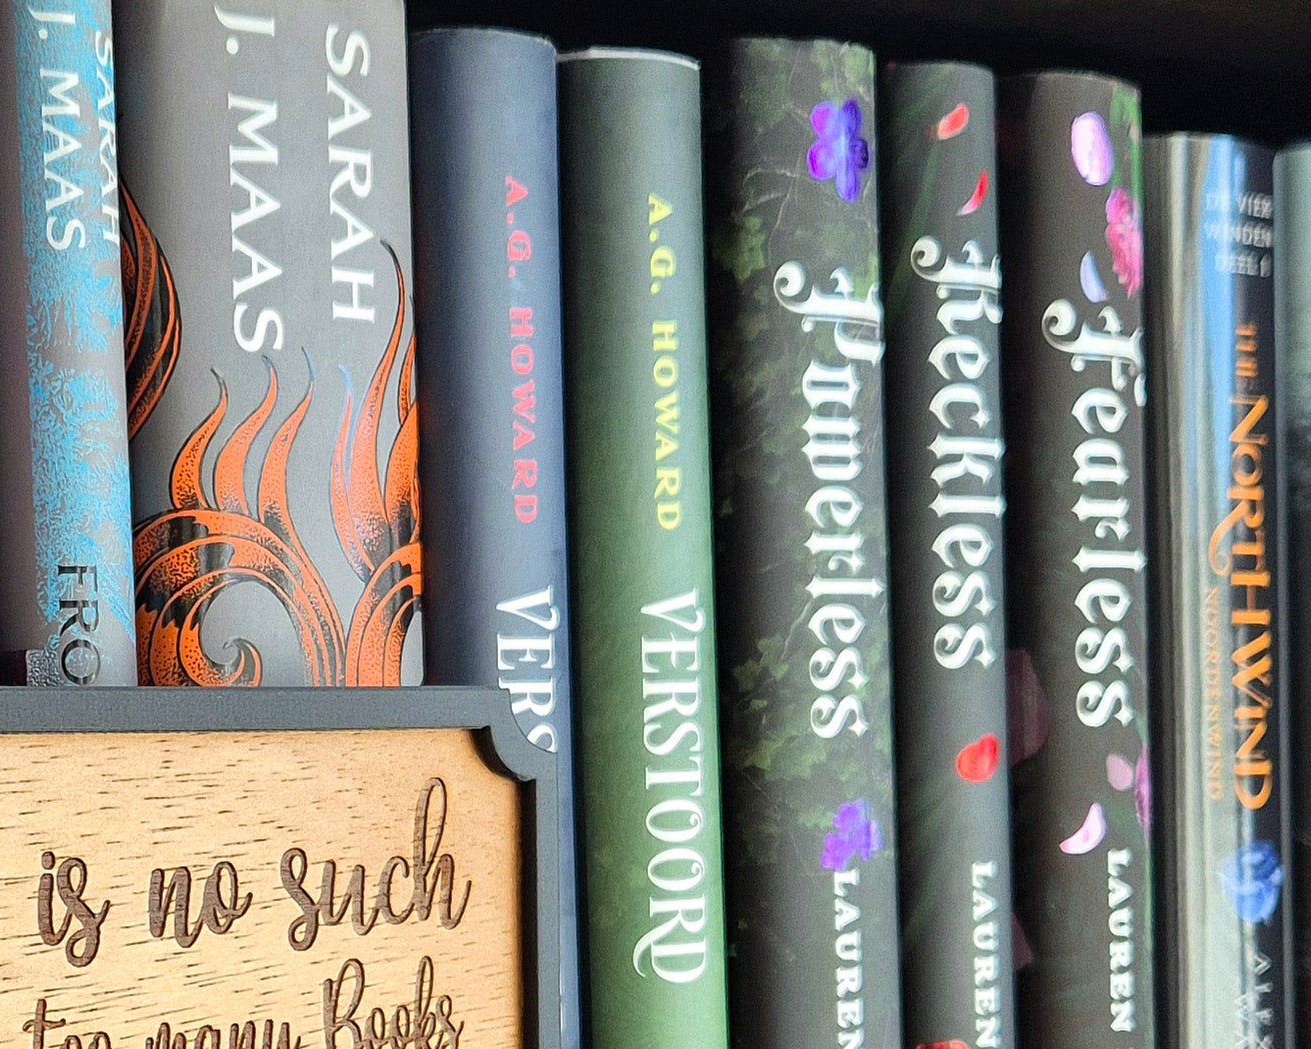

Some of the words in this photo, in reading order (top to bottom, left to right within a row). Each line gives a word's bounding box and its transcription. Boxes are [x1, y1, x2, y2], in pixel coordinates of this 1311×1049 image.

[29, 5, 77, 40] J.
[214, 6, 275, 55] J.
[39, 66, 87, 252] MAAS
[94, 29, 121, 245] SARAH
[227, 91, 285, 353] MAAS
[324, 22, 377, 324] SARAH
[504, 174, 533, 279] A.G.
[648, 193, 677, 295] A.G.
[507, 306, 541, 526] HOWARD
[652, 320, 682, 531] HOWARD
[773, 260, 886, 738] Powerless
[910, 235, 1007, 669] Reckless
[1041, 298, 1146, 728] Fearless
[57, 564, 101, 686] FRO
[495, 585, 560, 754] VERS
[35, 849, 112, 968] is
[147, 858, 255, 949] no
[279, 775, 475, 952] such
[633, 586, 709, 984] VERSTOORD
[971, 860, 1003, 1049] LAUREN
[1107, 847, 1138, 1033] LAUREN
